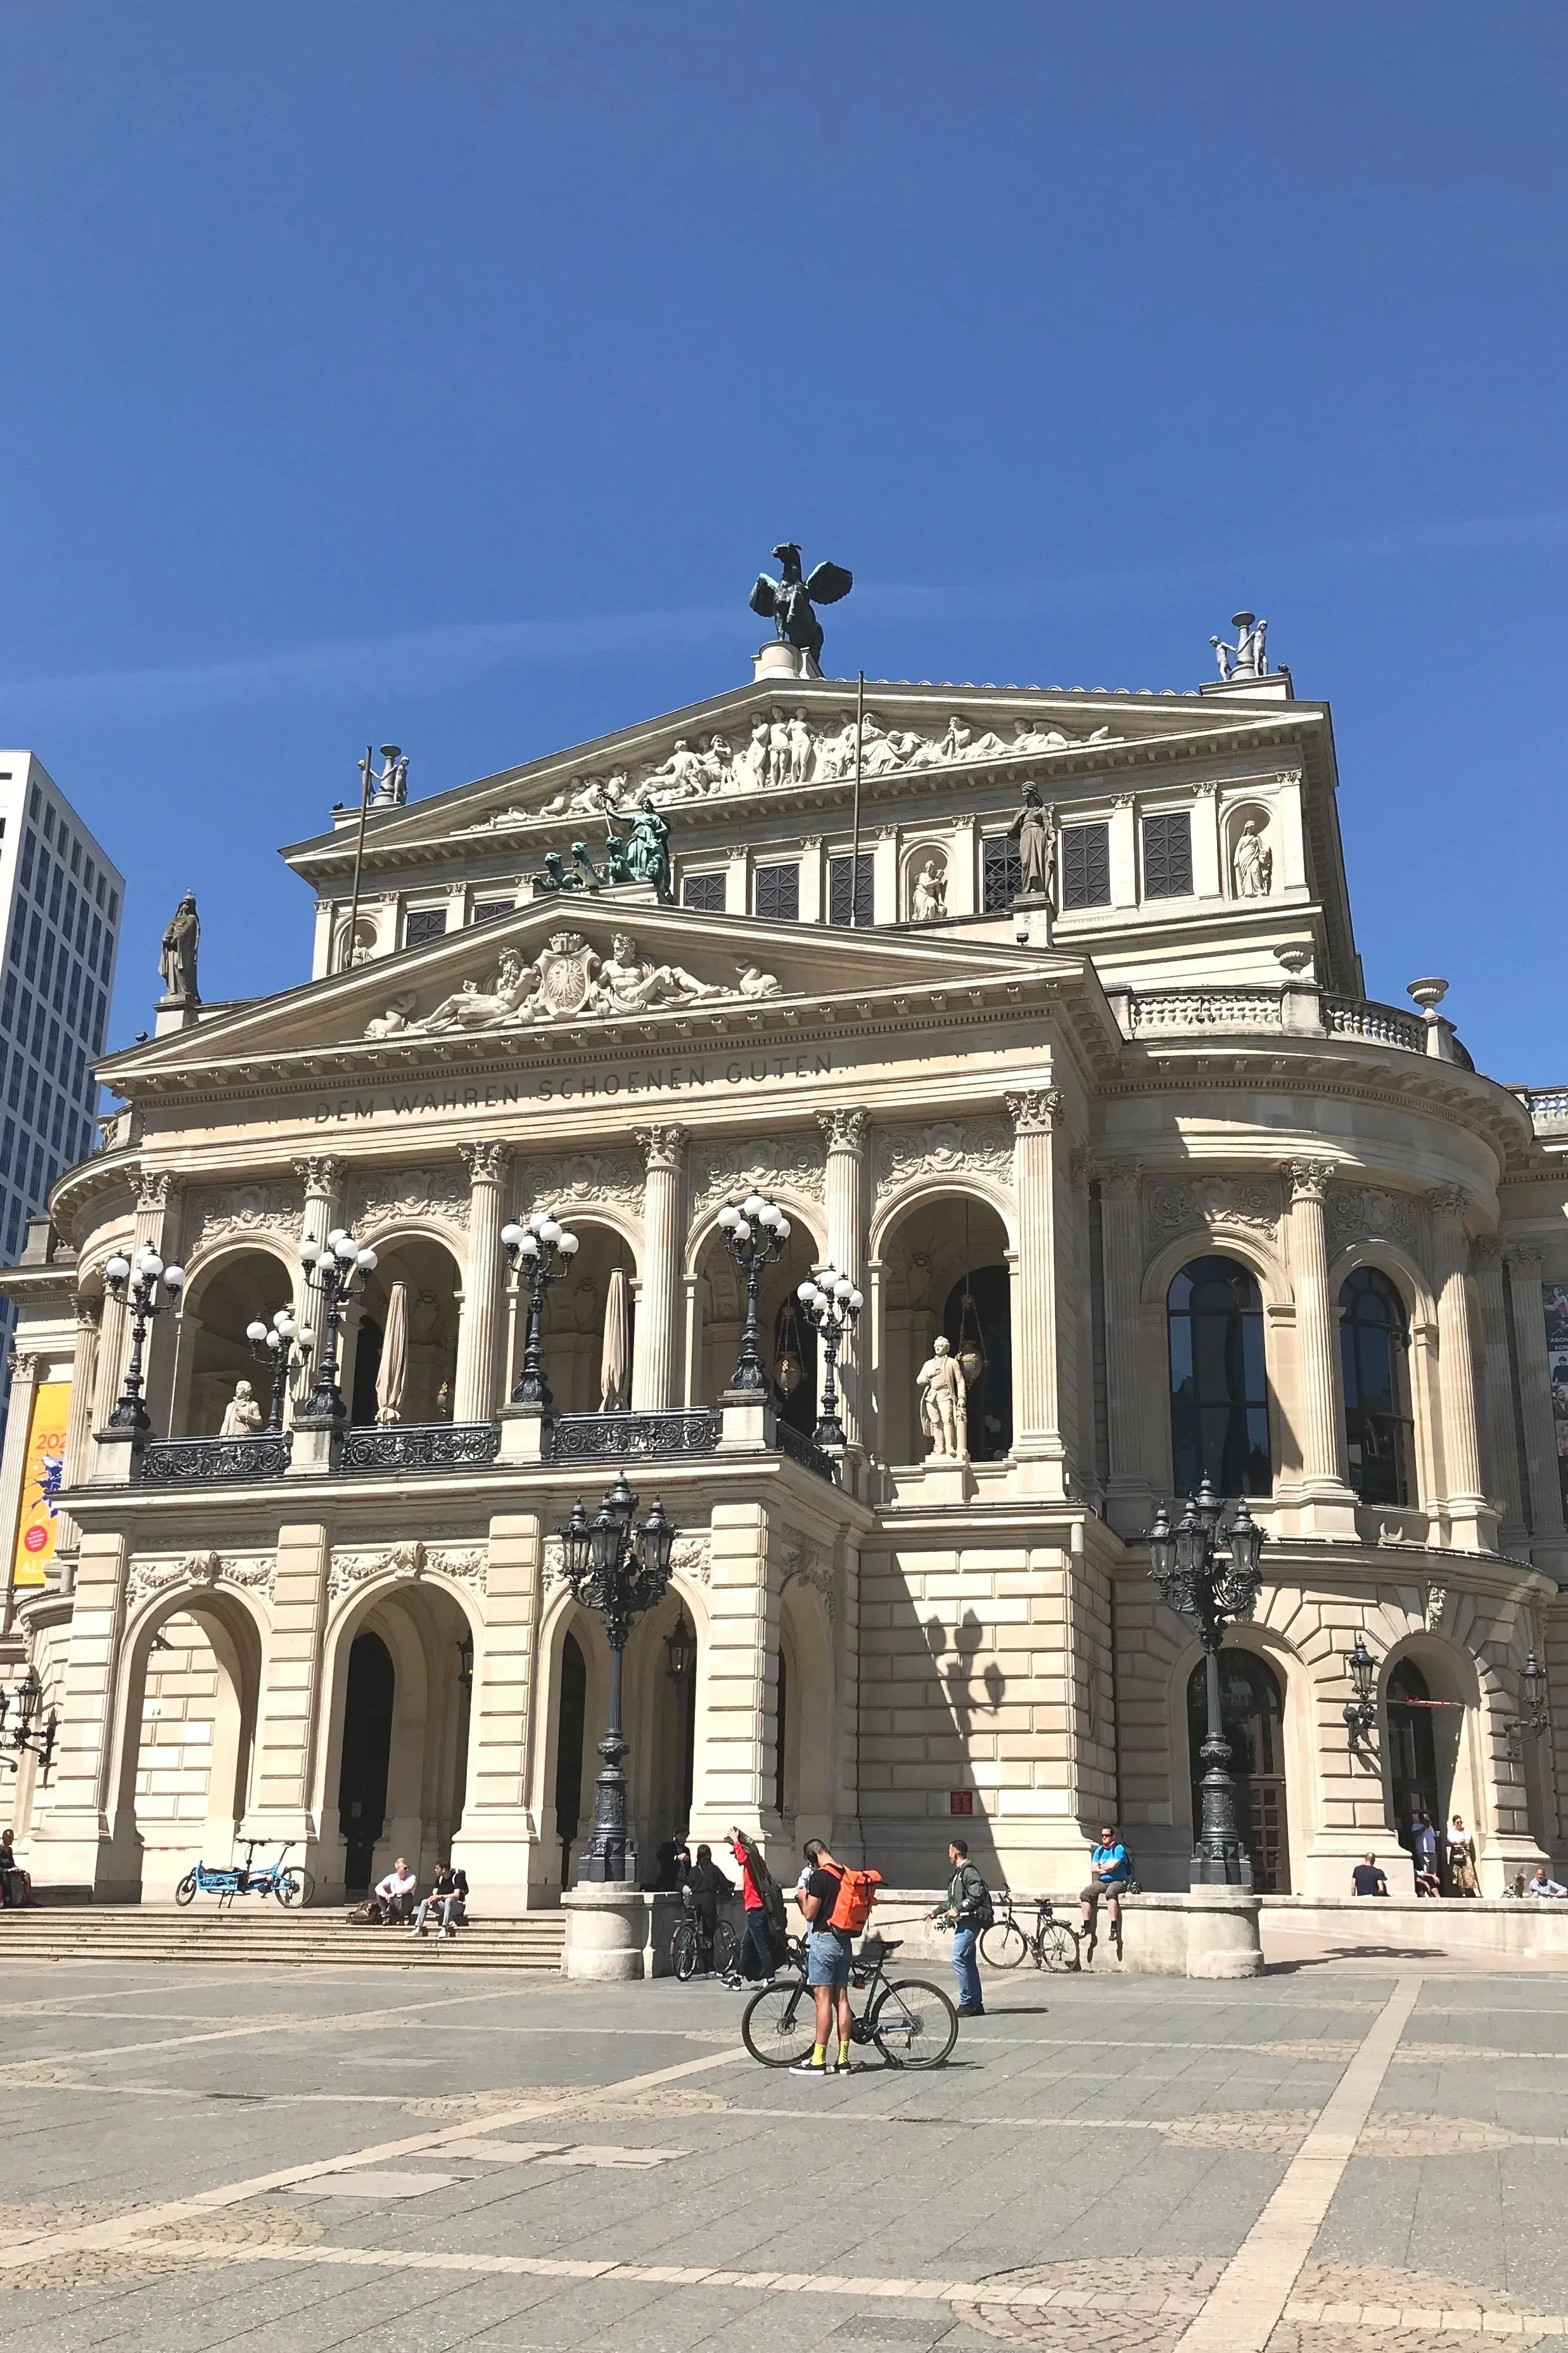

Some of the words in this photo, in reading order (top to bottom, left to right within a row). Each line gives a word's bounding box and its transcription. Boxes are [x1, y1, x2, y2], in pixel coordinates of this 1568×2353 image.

[315, 1098, 374, 1124] DEM
[390, 1082, 519, 1115] WAHREN
[538, 1065, 705, 1102] SCHOENEN
